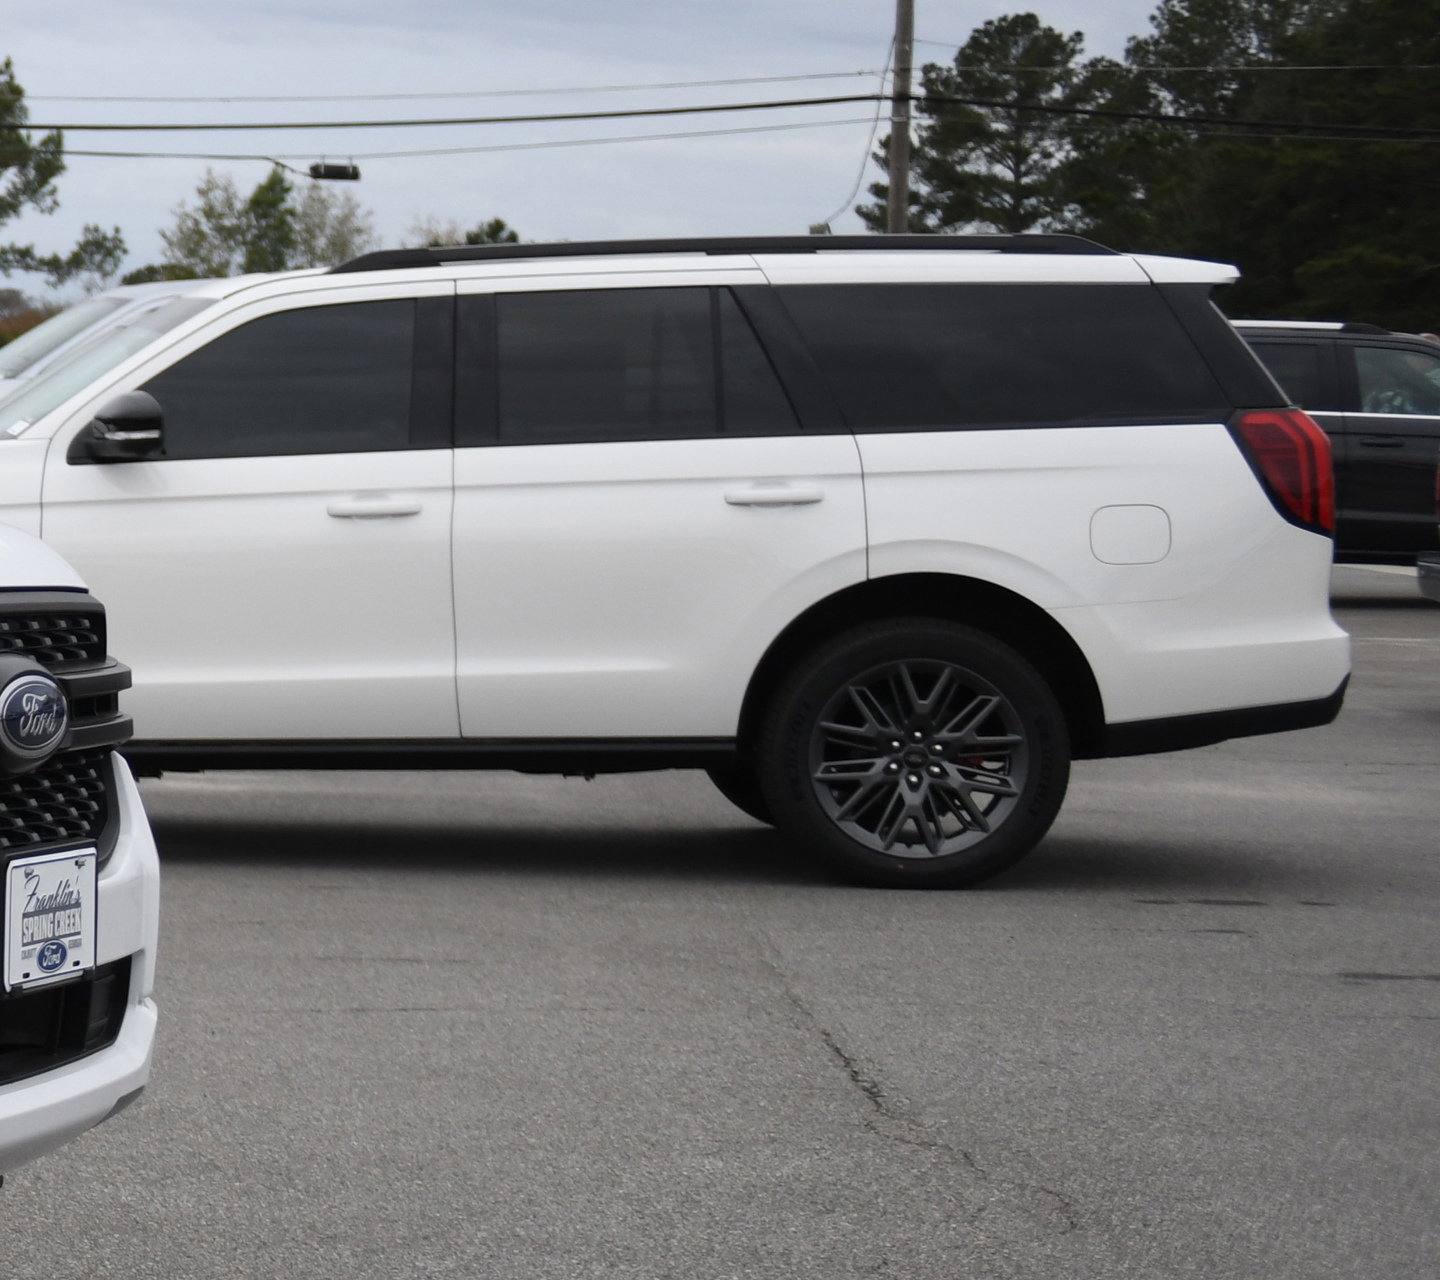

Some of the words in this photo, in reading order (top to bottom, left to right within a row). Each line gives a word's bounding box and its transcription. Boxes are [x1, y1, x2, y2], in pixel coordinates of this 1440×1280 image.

[20, 693, 57, 737] Ford
[23, 873, 81, 913] Franklin's
[23, 912, 54, 943] SPRING
[54, 907, 81, 937] CREEK
[42, 944, 62, 967] Ford
